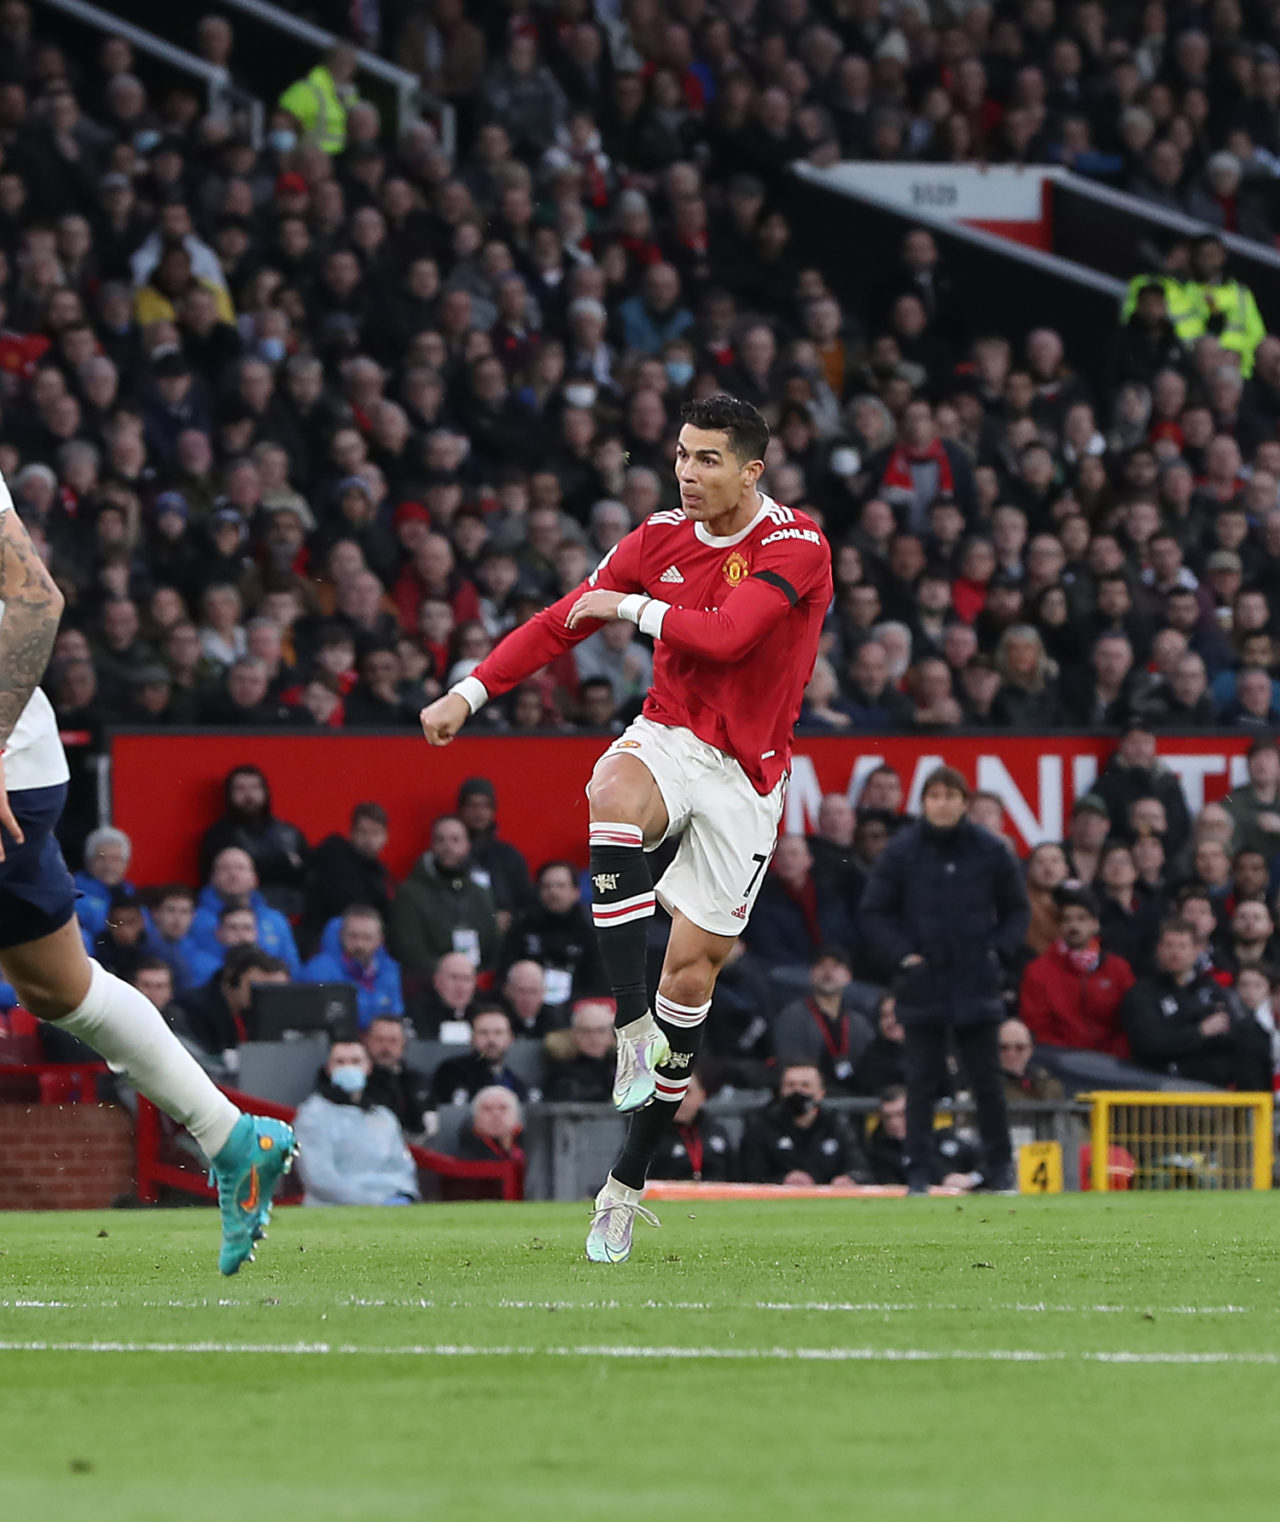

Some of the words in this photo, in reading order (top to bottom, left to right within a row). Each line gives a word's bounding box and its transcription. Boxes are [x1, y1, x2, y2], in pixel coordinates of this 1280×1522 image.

[761, 528, 822, 546] KOHLER
[742, 853, 768, 898] 7
[1031, 1161, 1049, 1191] 4
